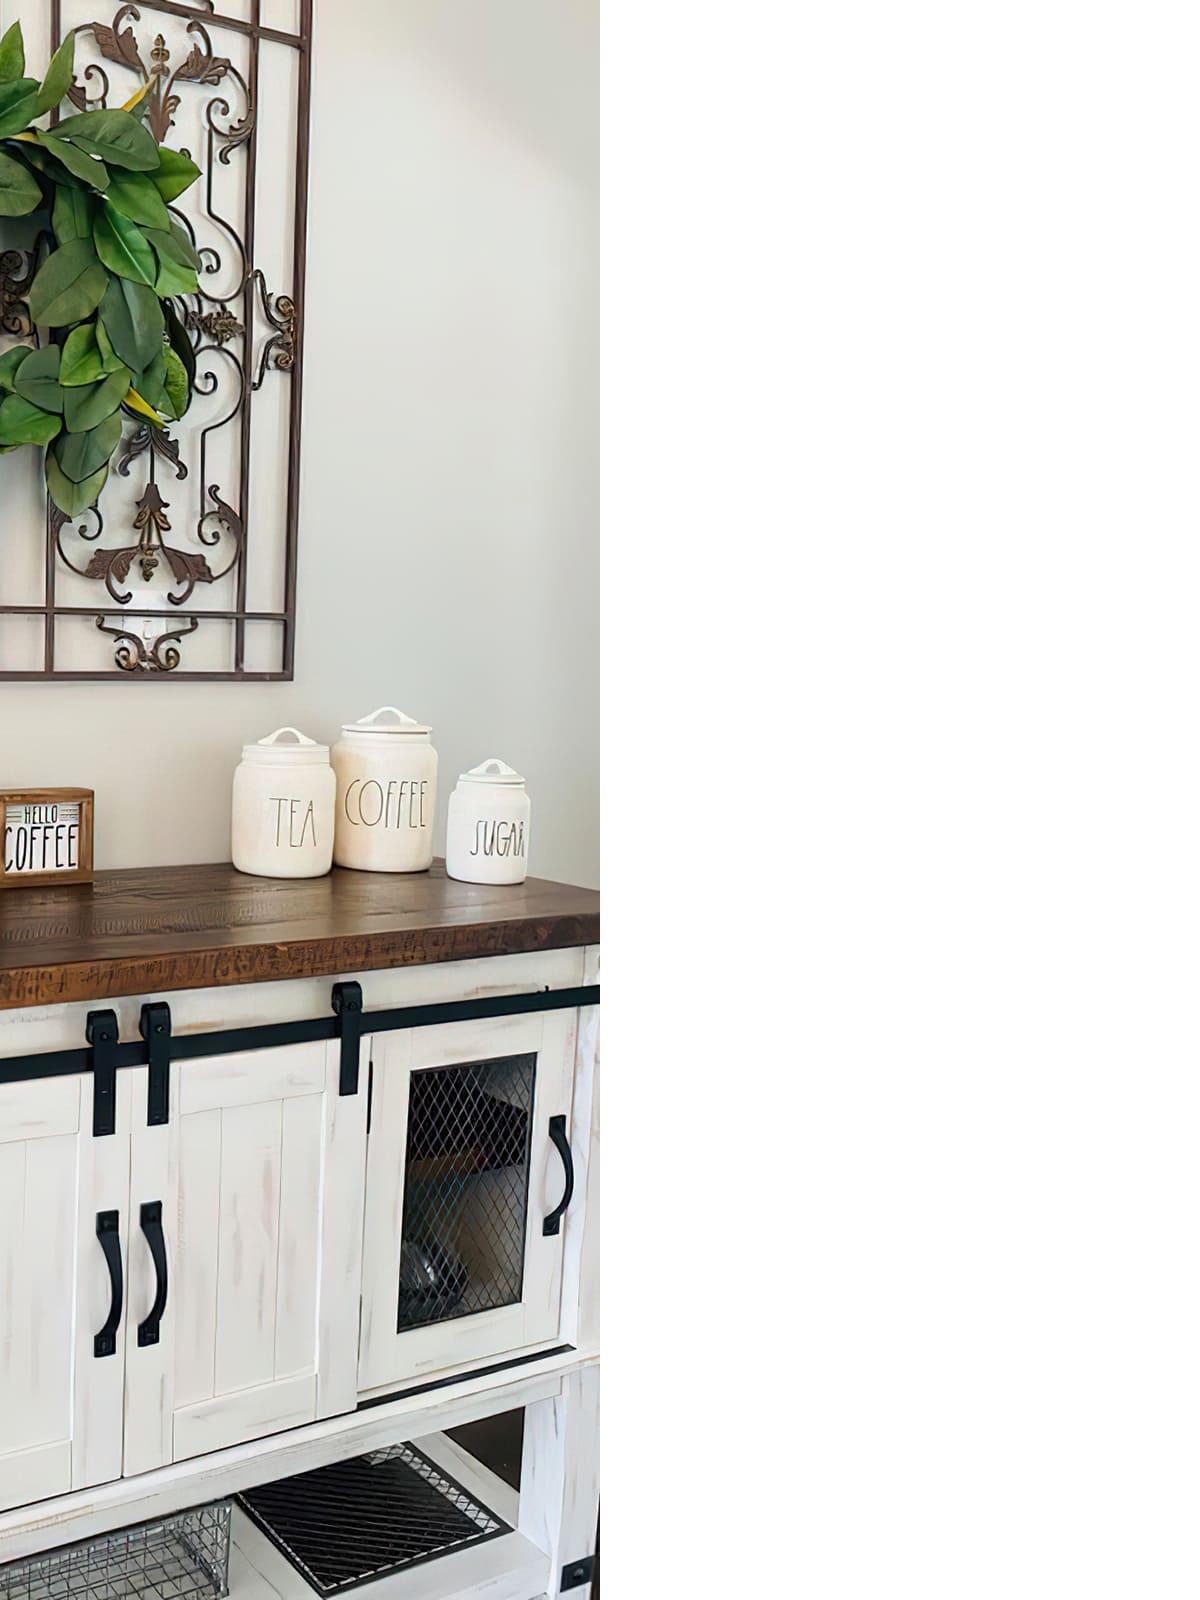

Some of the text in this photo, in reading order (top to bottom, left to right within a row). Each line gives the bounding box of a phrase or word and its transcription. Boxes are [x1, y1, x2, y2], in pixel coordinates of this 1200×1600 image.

[24, 805, 58, 824] HELLO
[269, 797, 317, 848] TEA
[344, 779, 428, 829] COFFEE
[4, 824, 79, 871] COFFEE
